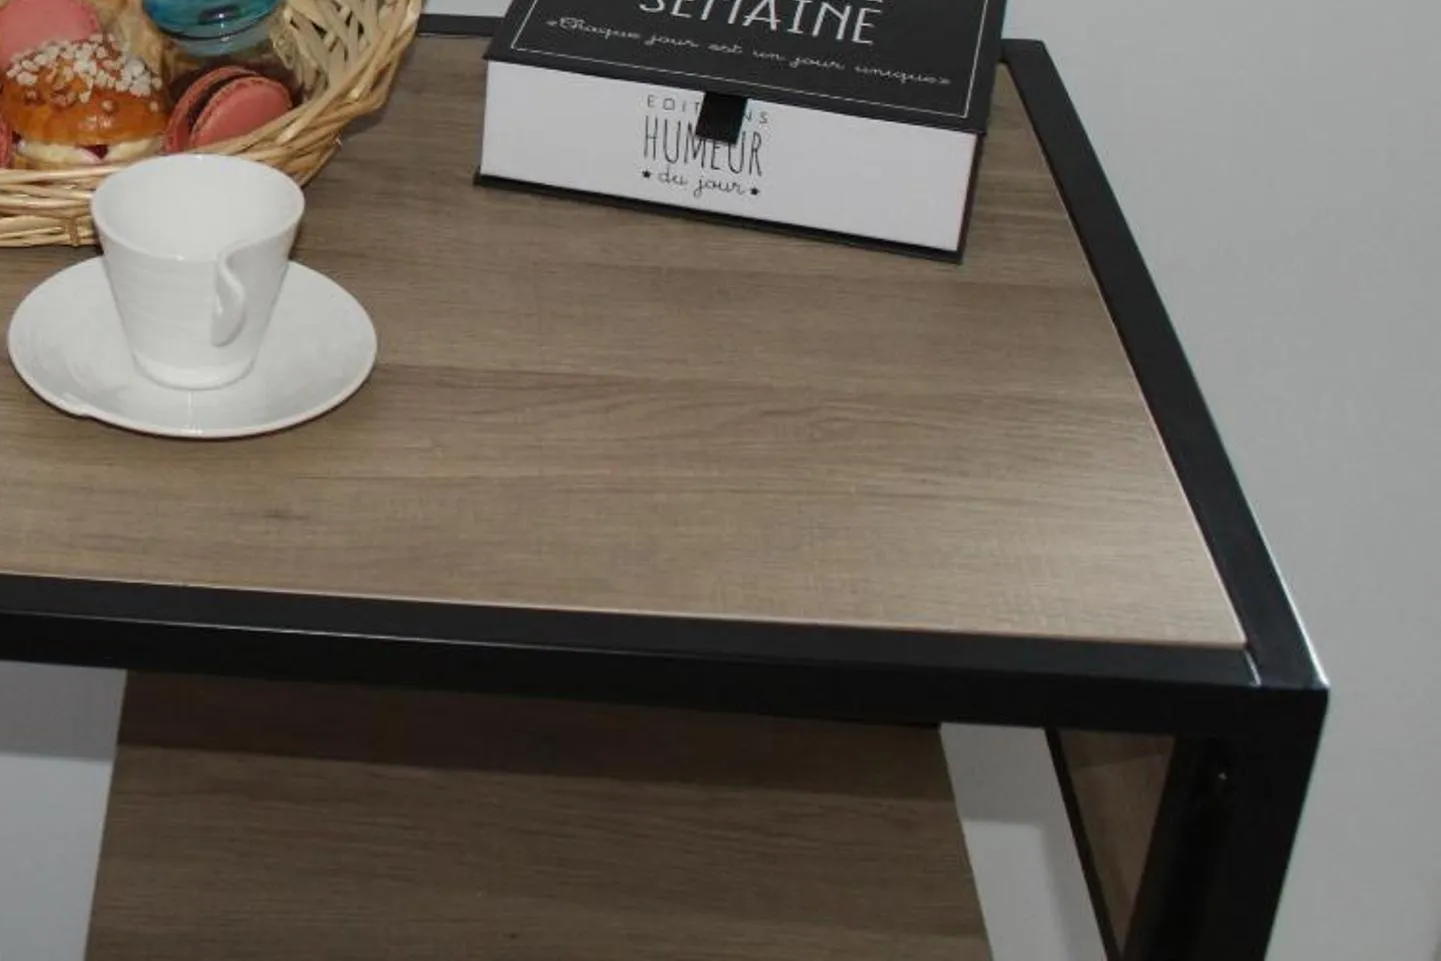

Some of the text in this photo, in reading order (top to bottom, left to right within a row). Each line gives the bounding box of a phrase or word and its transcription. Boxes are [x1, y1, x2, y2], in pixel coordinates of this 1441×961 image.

[644, 33, 700, 48] jour
[708, 43, 744, 55] est
[752, 48, 787, 62] un
[789, 53, 845, 70] jour
[647, 94, 769, 125] EDITNS
[643, 115, 763, 177] HUMEUR
[658, 165, 746, 198] du jour
